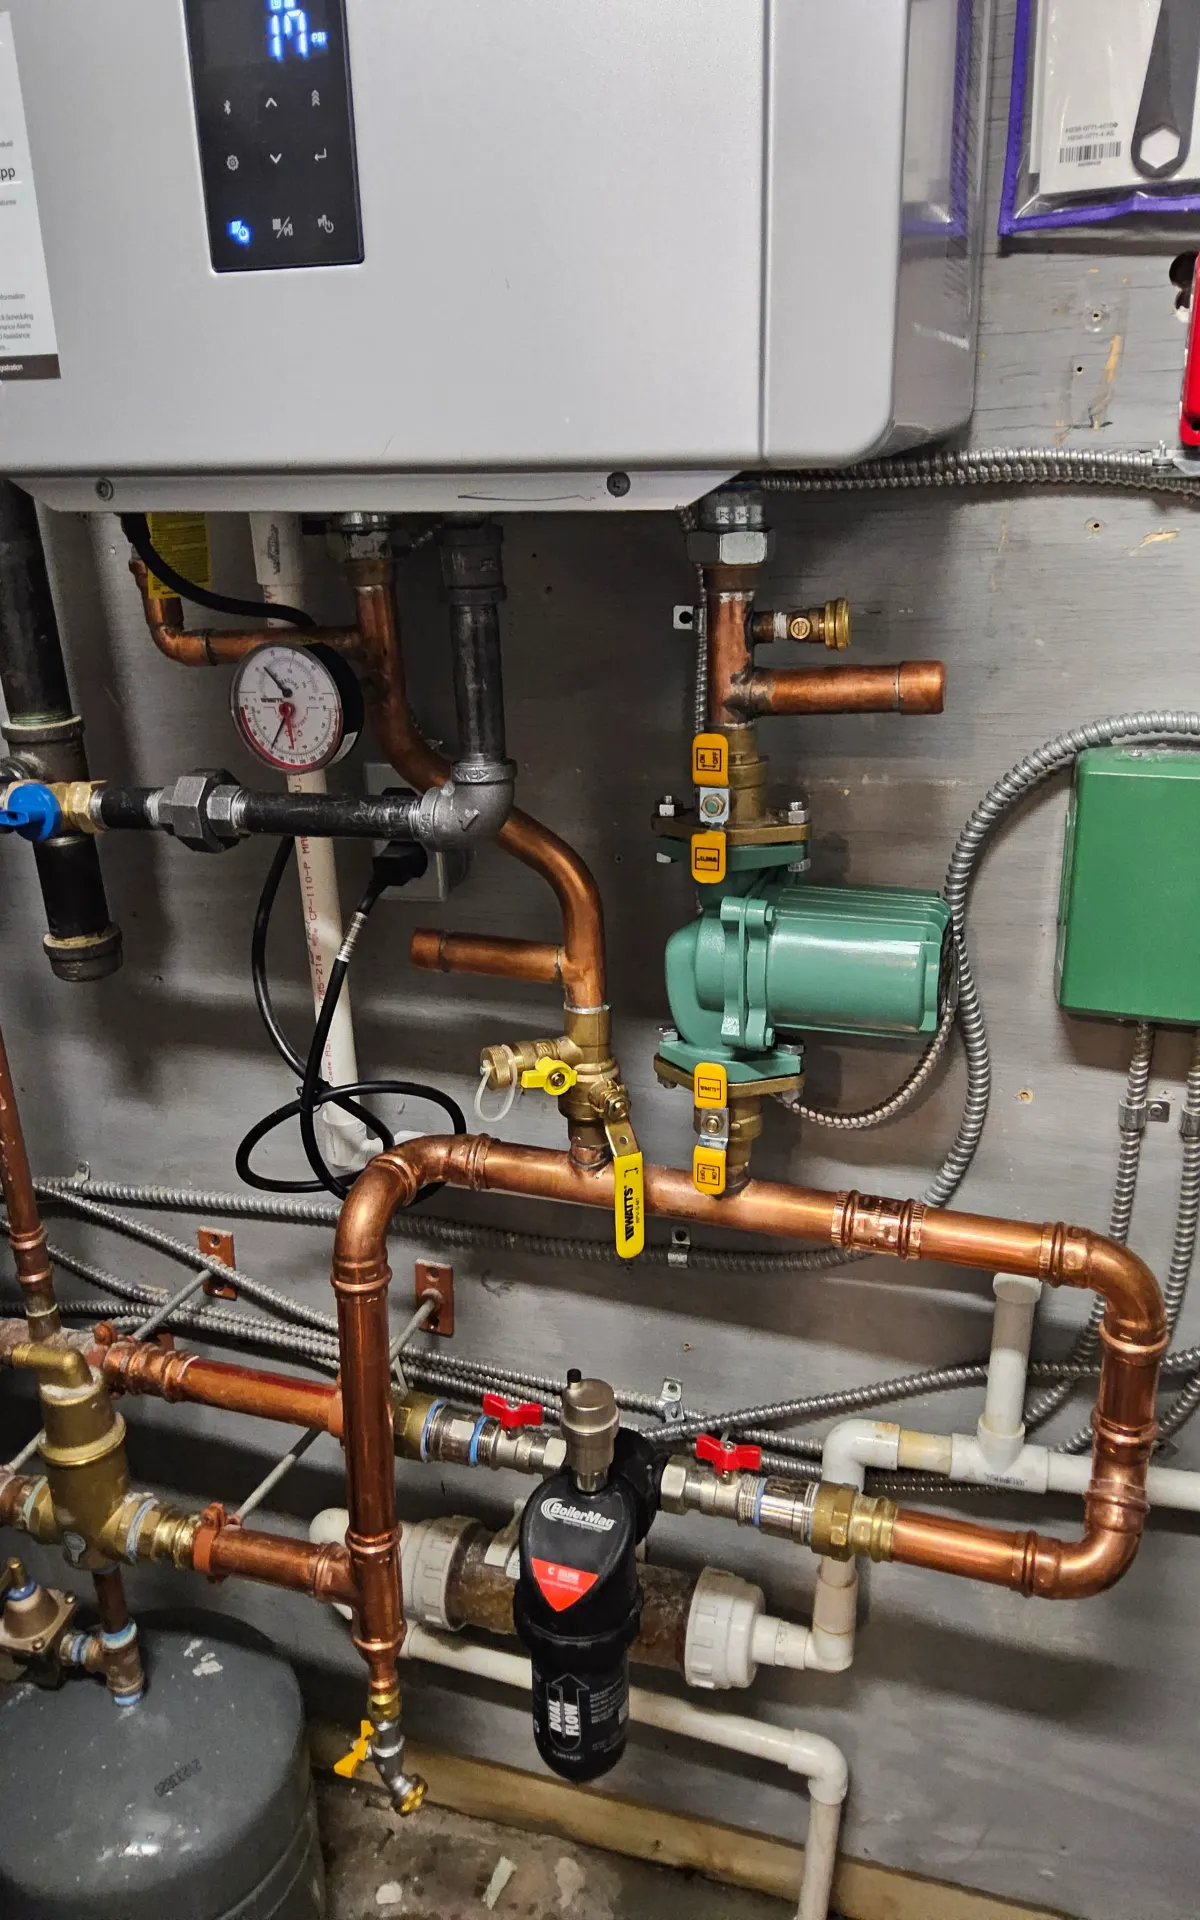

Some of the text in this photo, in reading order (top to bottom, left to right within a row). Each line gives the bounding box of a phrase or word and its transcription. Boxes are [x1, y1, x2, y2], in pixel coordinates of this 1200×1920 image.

[311, 31, 327, 43] PSI
[0, 167, 16, 181] pp
[699, 754, 706, 764] ON
[623, 1186, 635, 1230] WATTS
[550, 1502, 616, 1529] BoilerMag
[548, 1699, 562, 1733] DUAL
[563, 1702, 580, 1737] FLOW
